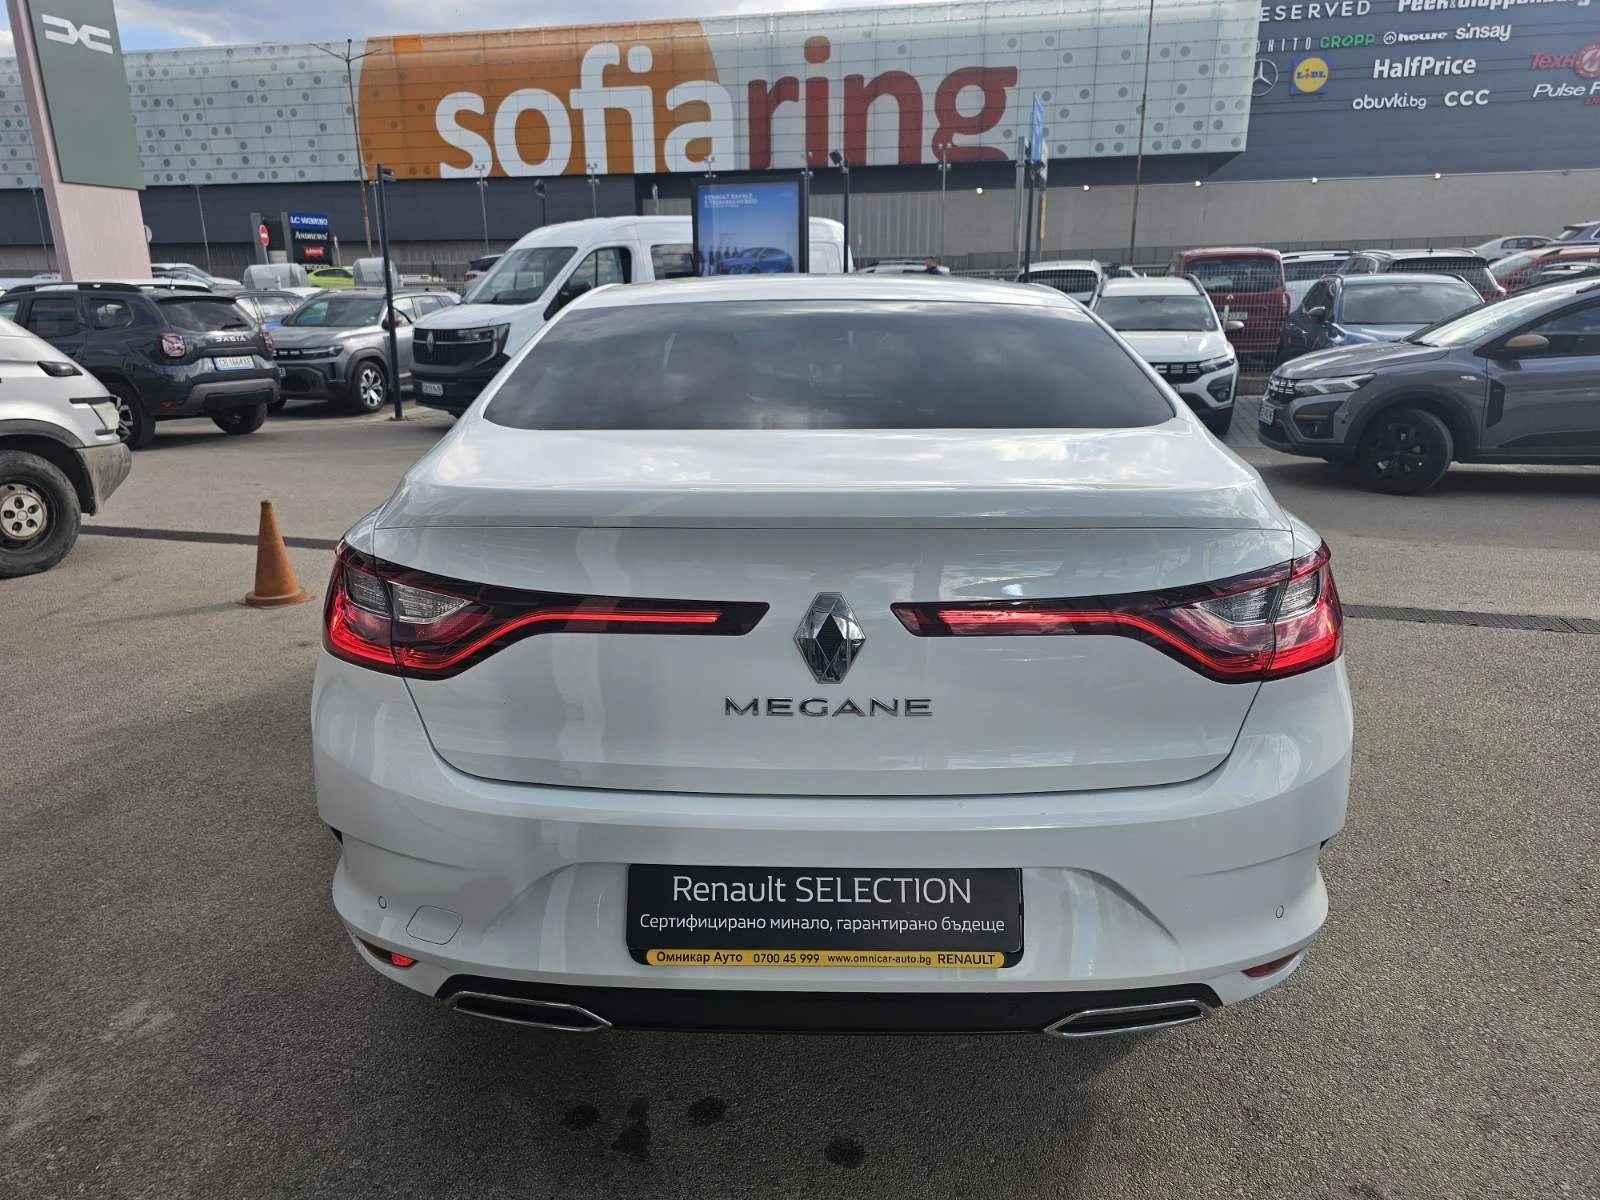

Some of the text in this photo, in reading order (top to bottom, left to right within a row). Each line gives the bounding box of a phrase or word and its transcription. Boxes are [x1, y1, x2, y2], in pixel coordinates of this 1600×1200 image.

[1260, 0, 1370, 22] ESERVED
[1320, 33, 1376, 49] CROPP
[1455, 23, 1512, 42] sinsay
[1373, 55, 1477, 79] HalfPrice
[1444, 89, 1490, 107] CCC
[1532, 82, 1586, 98] Pulse
[1352, 92, 1427, 110] obuvki.bg
[725, 696, 933, 717] MEGANE
[673, 875, 971, 905] Renault SELECTION
[640, 913, 1005, 934] Сертифицирано минало, гарантирано бъдеще
[656, 951, 996, 966] Омникар Ауто 0700 45 999 www.omnicar-auto.bg RENAULT
